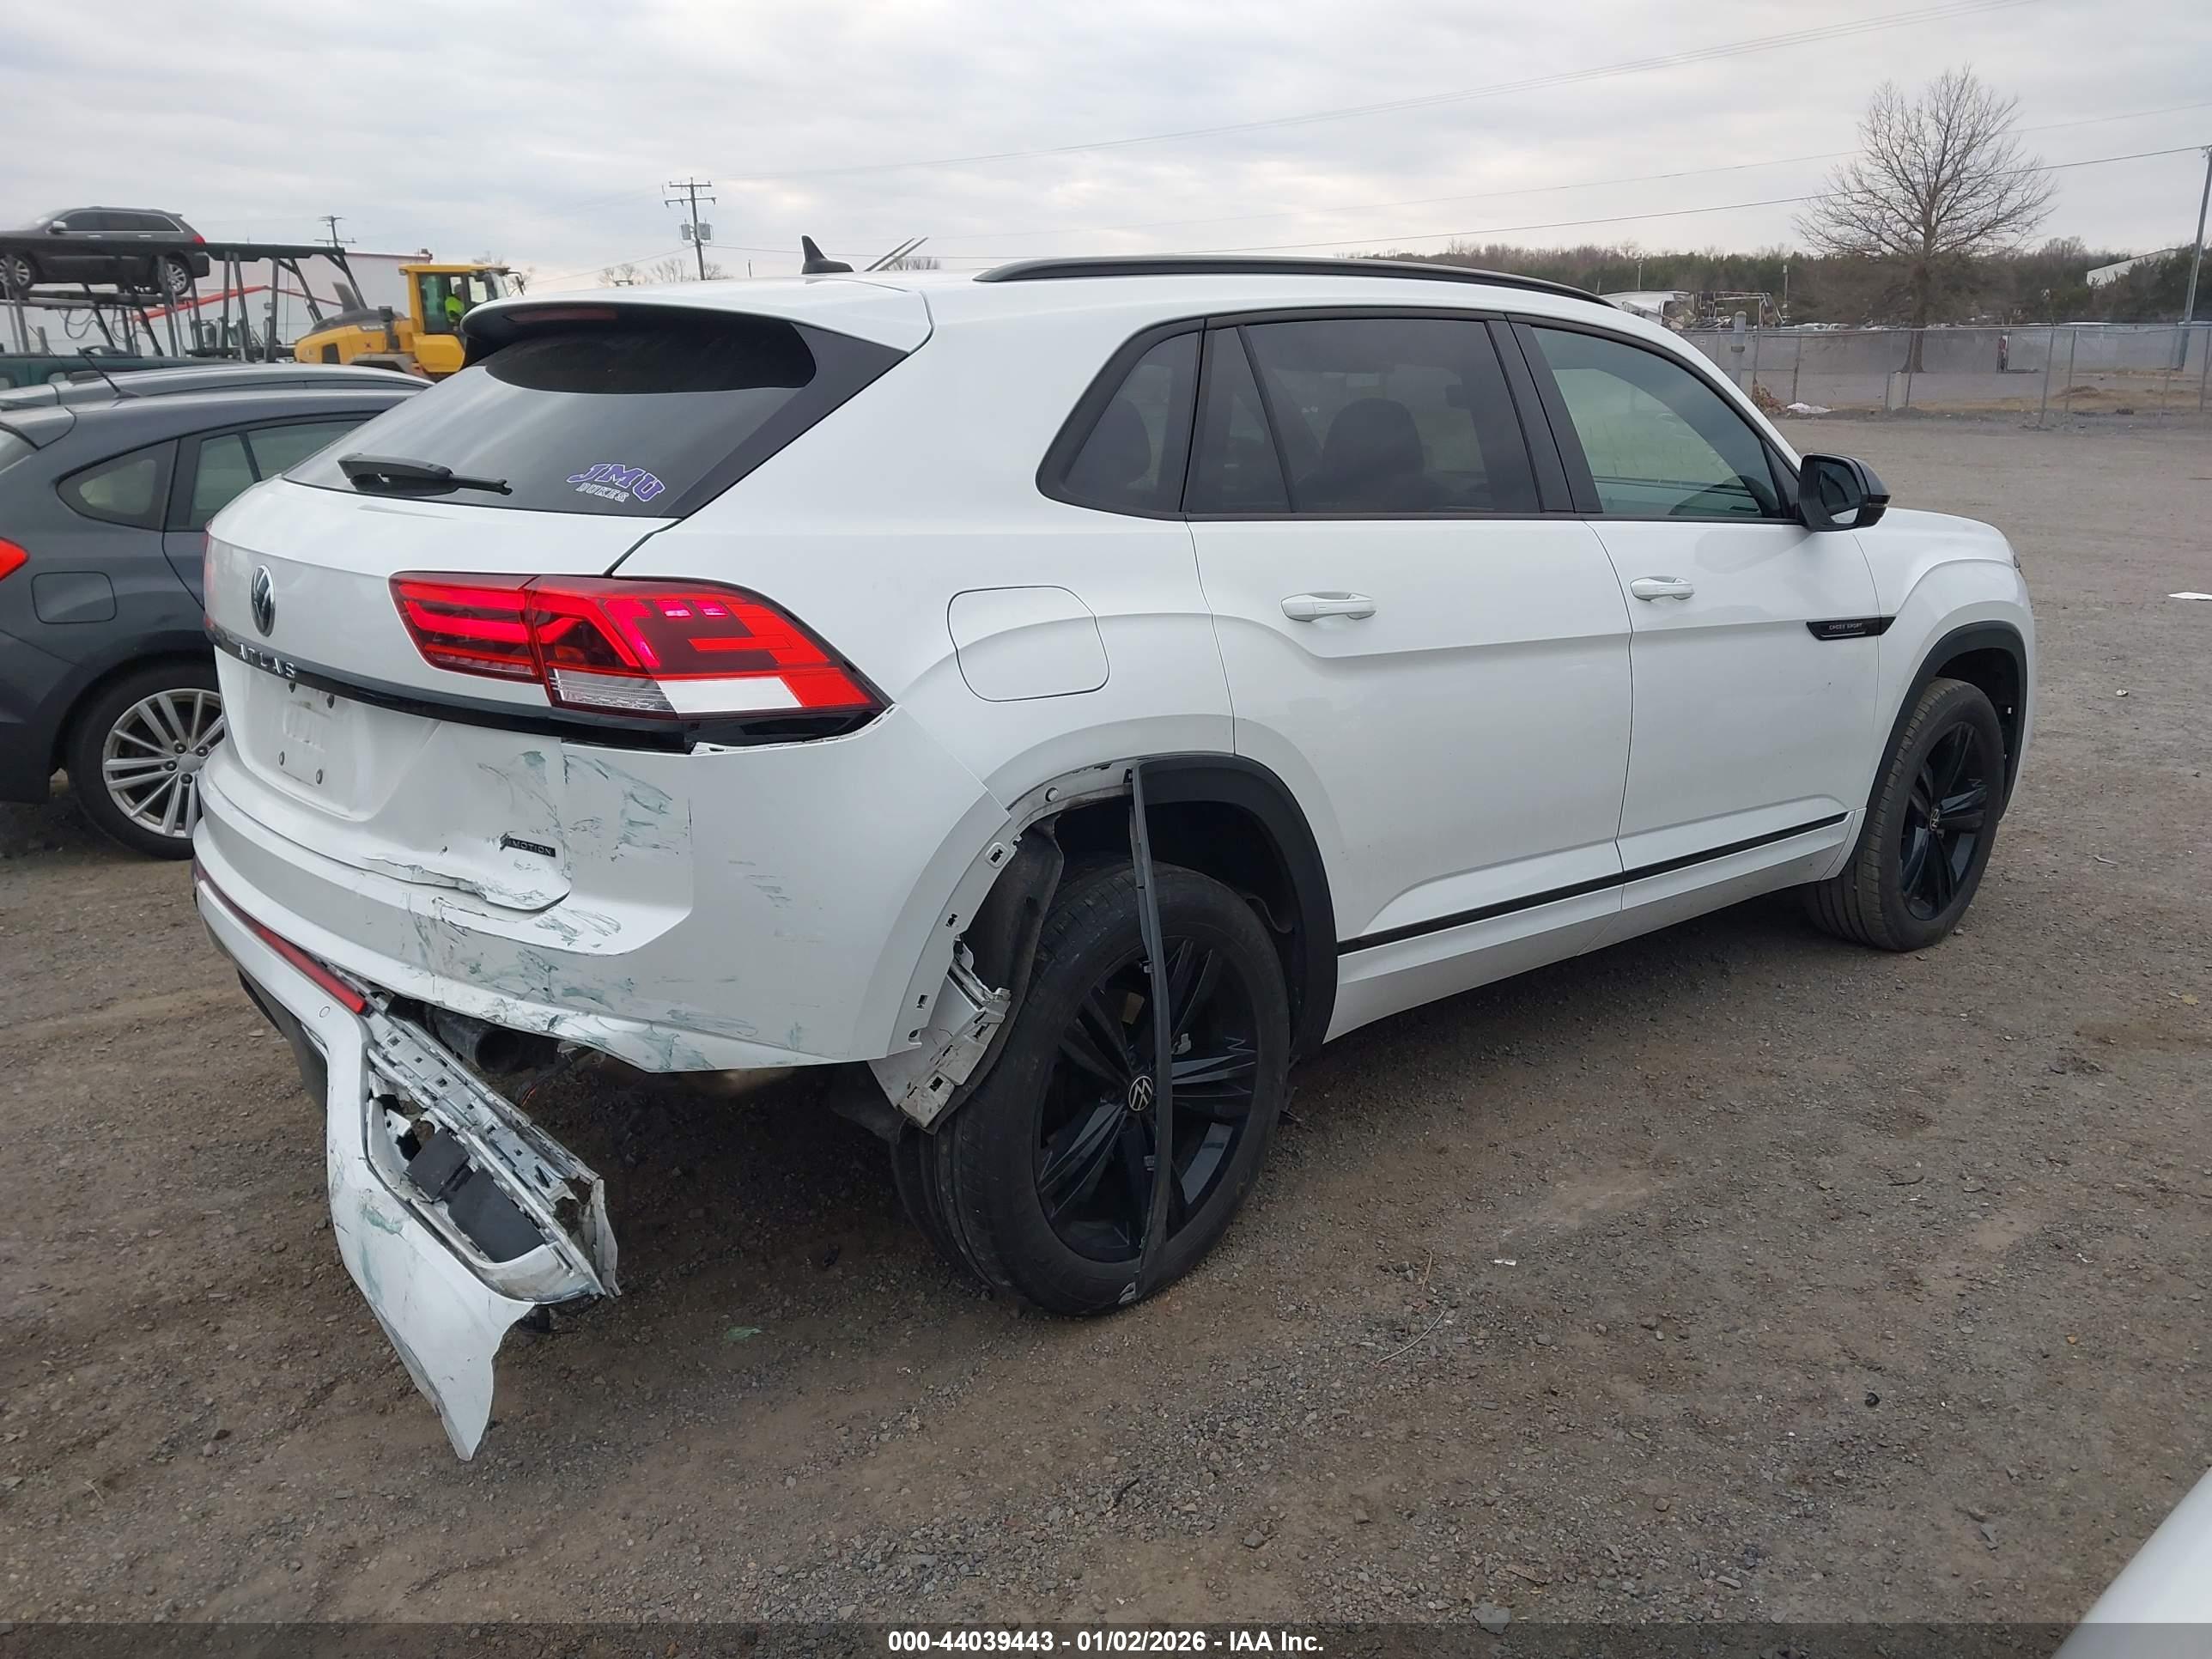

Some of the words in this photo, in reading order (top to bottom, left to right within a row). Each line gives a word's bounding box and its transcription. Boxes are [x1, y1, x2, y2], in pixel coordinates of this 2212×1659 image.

[566, 463, 665, 501] JMU
[575, 482, 629, 502] DUKES
[239, 643, 295, 678] ATLAS
[501, 836, 552, 856] MOTION
